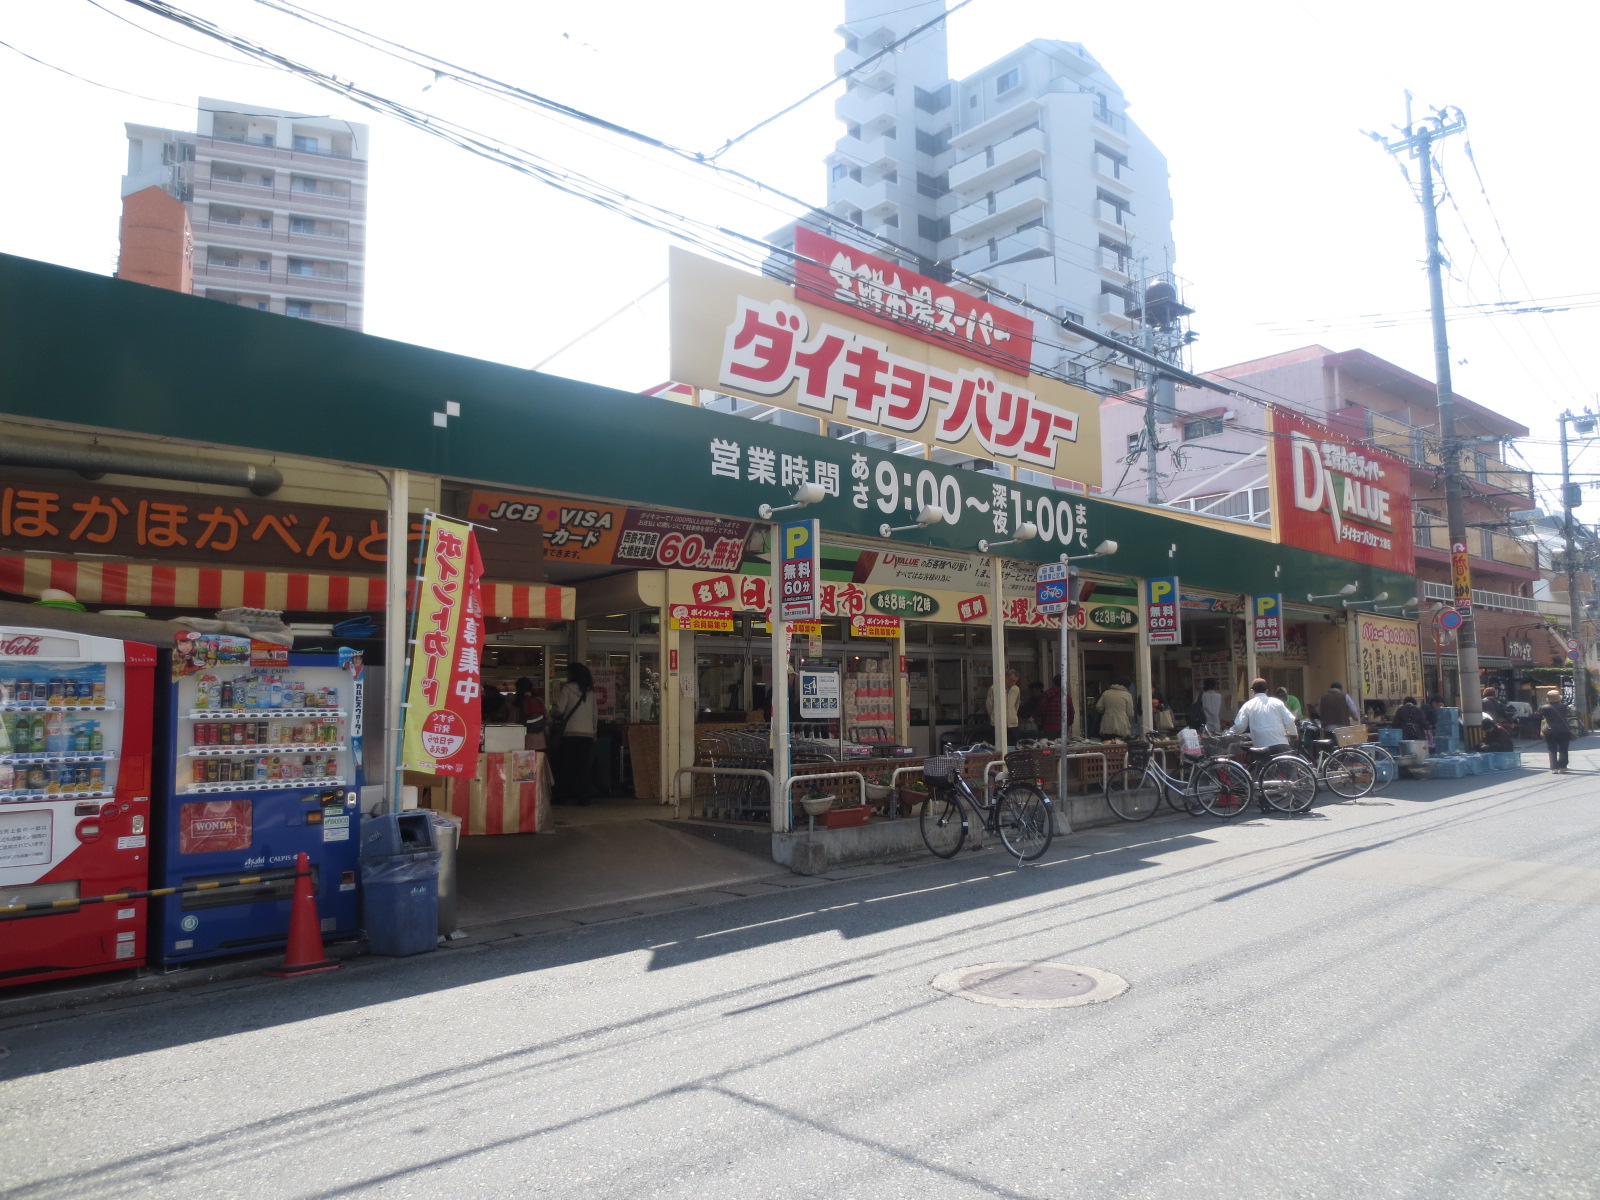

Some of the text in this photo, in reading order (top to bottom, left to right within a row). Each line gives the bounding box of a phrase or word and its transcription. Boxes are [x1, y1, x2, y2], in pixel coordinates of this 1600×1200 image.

[830, 251, 1010, 347] 生鮮市場スーパー
[723, 299, 1077, 466] ダイキョーバリュー
[710, 437, 840, 497] 営業時間
[490, 501, 613, 530] JCB VISA
[787, 526, 808, 559] P
[783, 560, 811, 580] 無料
[697, 581, 729, 603] 名物
[784, 580, 811, 595] 60分
[1152, 581, 1171, 604] P
[691, 608, 730, 617] ポイントカード
[961, 600, 983, 618] 恒例
[1150, 605, 1174, 617] 無料
[1257, 597, 1276, 616] P
[693, 620, 728, 629] 会員募集中
[1151, 618, 1173, 628] 60分
[1256, 617, 1277, 628] 無料
[1256, 629, 1277, 637] 60分
[195, 819, 233, 832] WONDA
[244, 854, 292, 867] Asahi CALPIS
